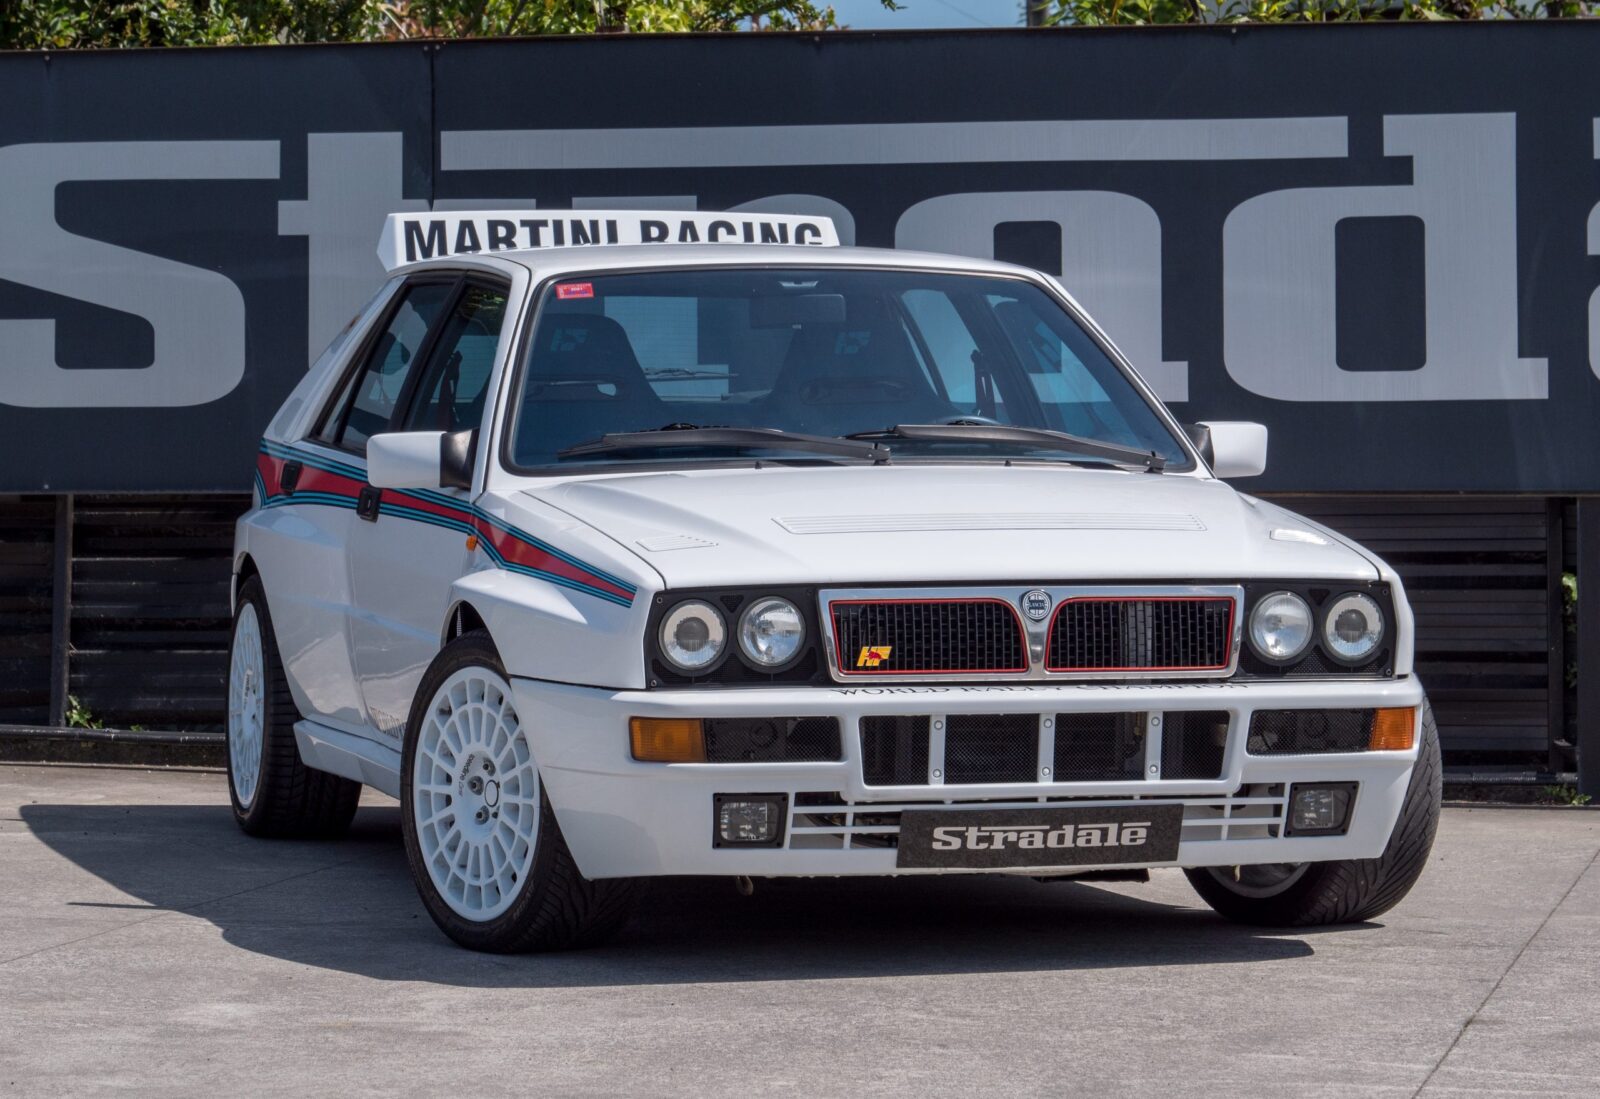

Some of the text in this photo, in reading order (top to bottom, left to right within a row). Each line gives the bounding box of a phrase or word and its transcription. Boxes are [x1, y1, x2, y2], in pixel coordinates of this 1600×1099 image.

[404, 219, 823, 262] MARTINI RACING
[857, 646, 892, 666] HF
[830, 687, 951, 696] WORLD
[932, 822, 1151, 850] Stradale
